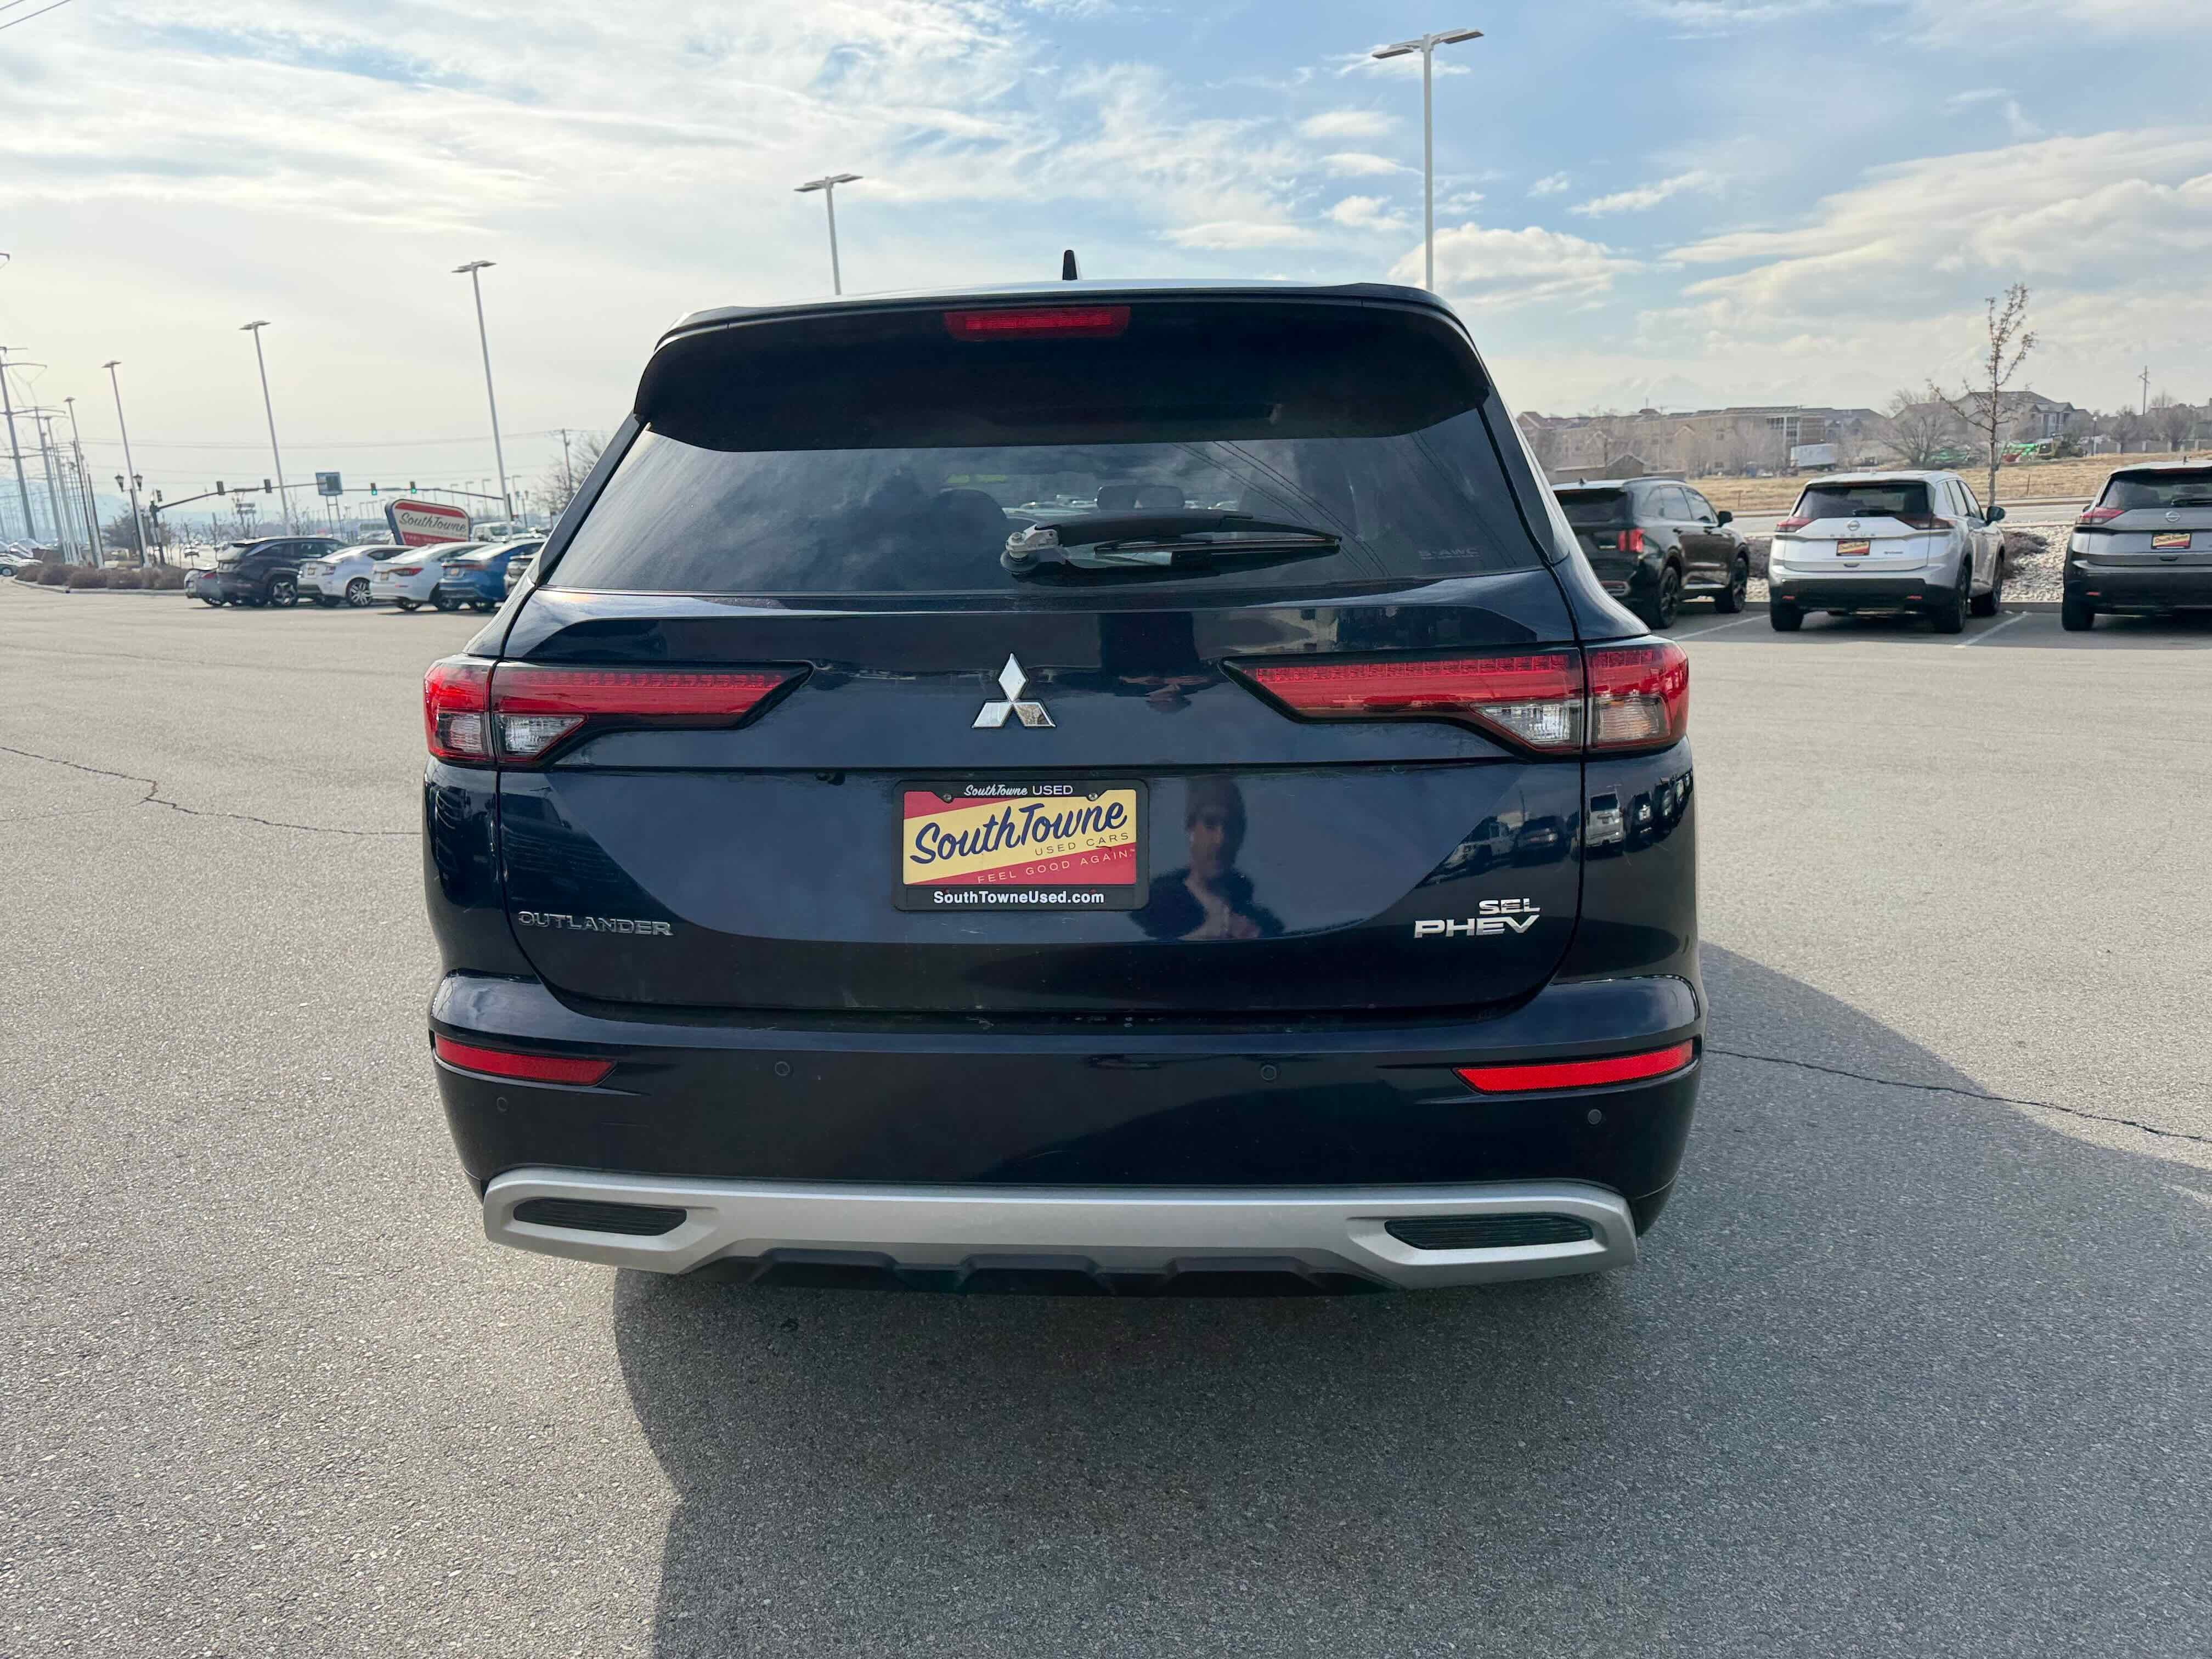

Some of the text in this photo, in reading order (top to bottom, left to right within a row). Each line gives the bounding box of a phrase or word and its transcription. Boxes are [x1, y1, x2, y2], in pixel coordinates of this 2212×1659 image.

[399, 512, 466, 531] SouthTowne
[964, 785, 1073, 796] SouthTowne USED
[910, 802, 1127, 864] SouthTowne
[1035, 832, 1129, 856] USED CARS
[977, 871, 1017, 884] FEEL
[1025, 860, 1070, 875] GOOD
[934, 890, 1104, 904] SouthTowneUsed.com
[1479, 898, 1541, 915] SEL
[518, 911, 674, 936] OUTLANDER
[1414, 915, 1540, 938] PHEV
